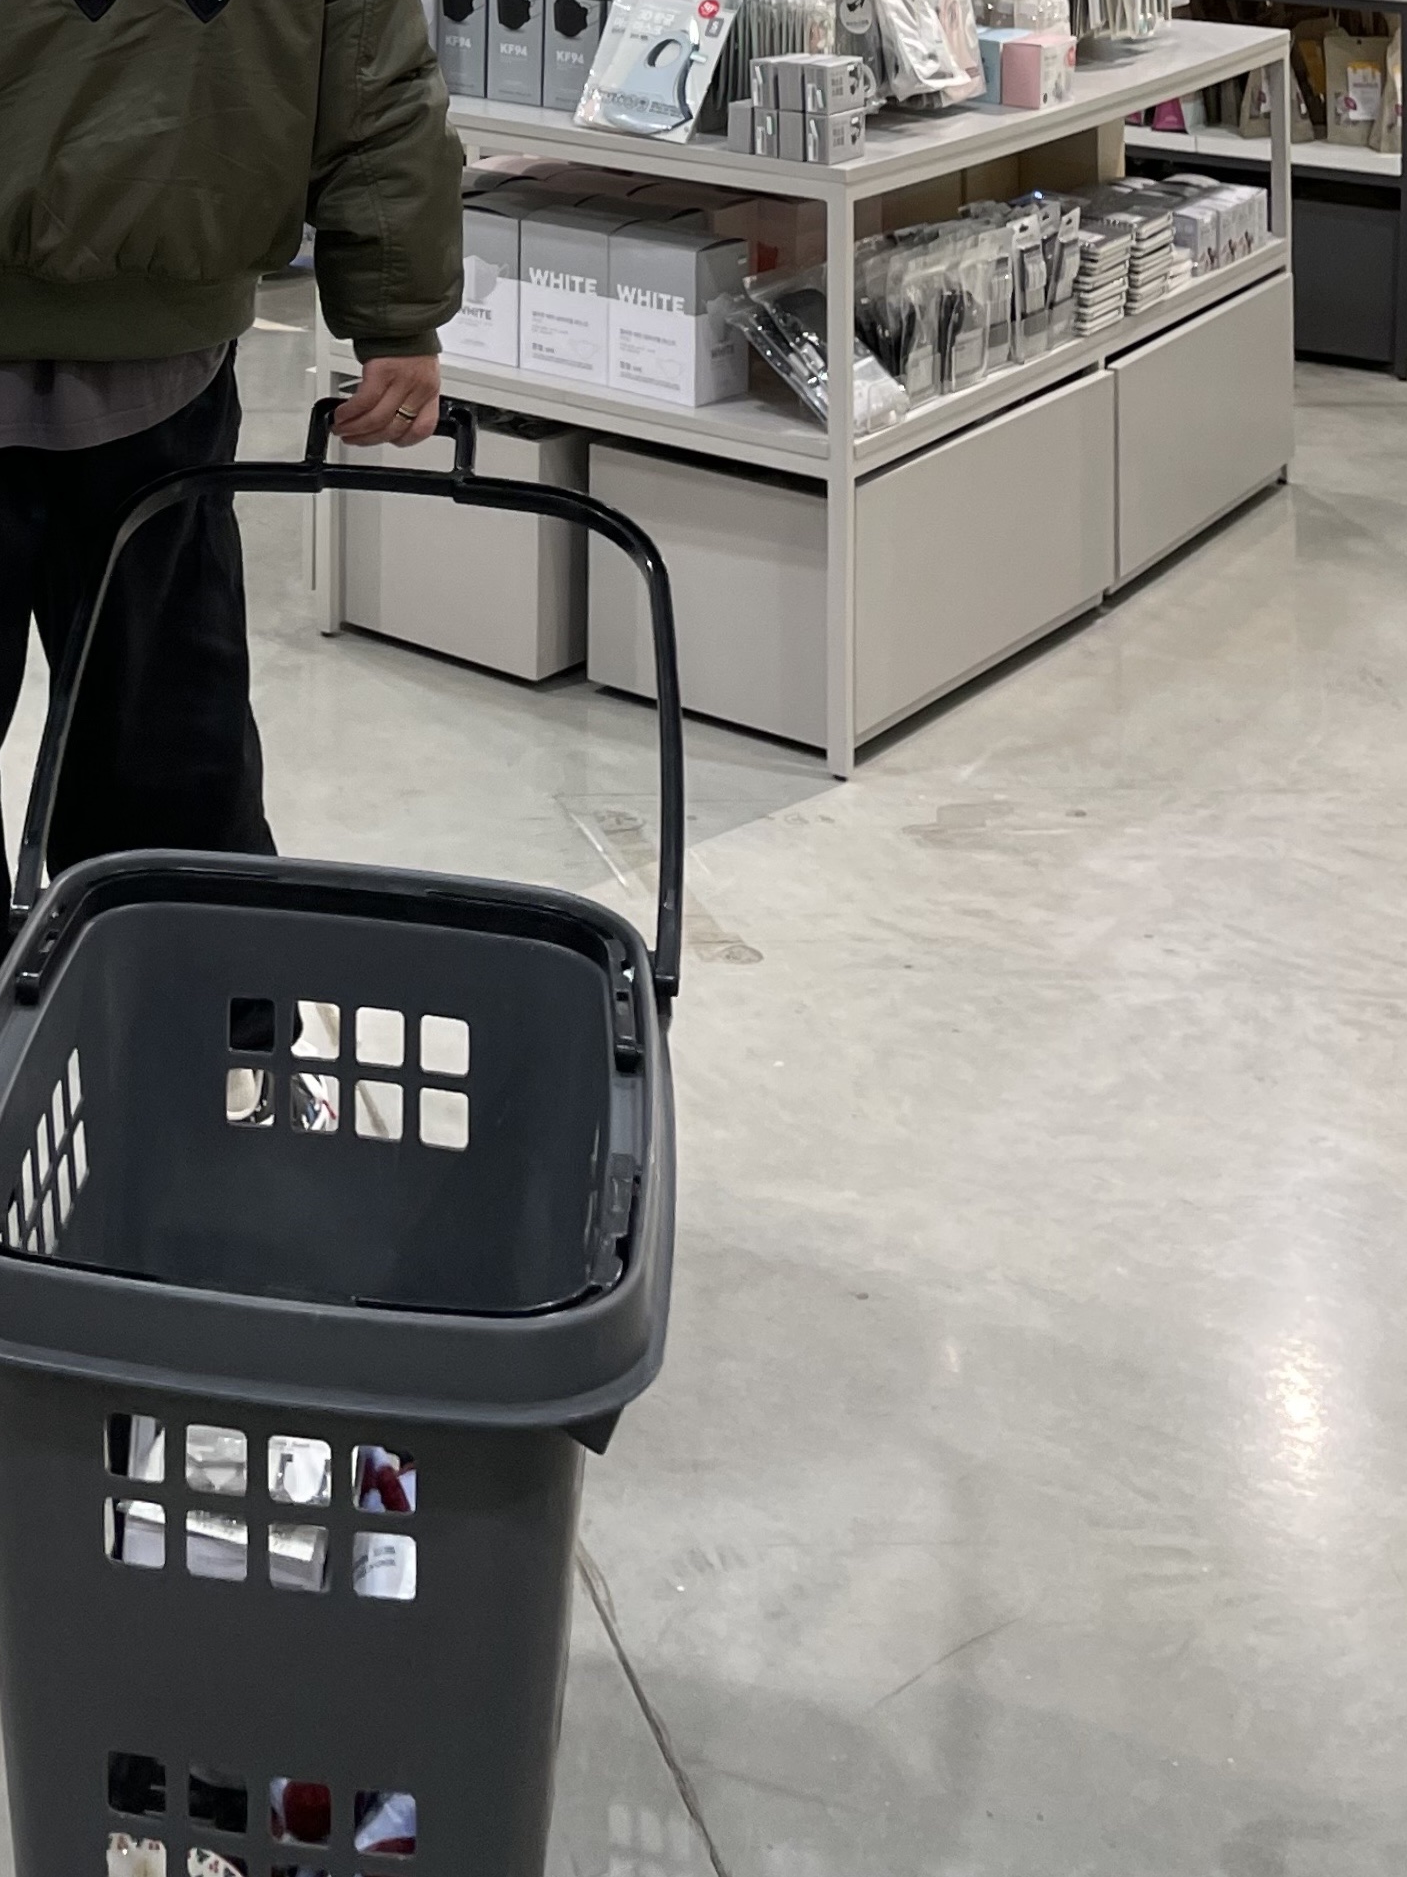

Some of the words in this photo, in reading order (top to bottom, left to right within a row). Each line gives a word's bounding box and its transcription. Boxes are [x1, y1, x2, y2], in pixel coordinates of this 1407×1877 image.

[445, 35, 472, 49] KF94
[499, 42, 528, 57] KF94
[555, 50, 585, 65] KF94
[529, 266, 598, 297] WHITE
[616, 283, 686, 316] WHITE
